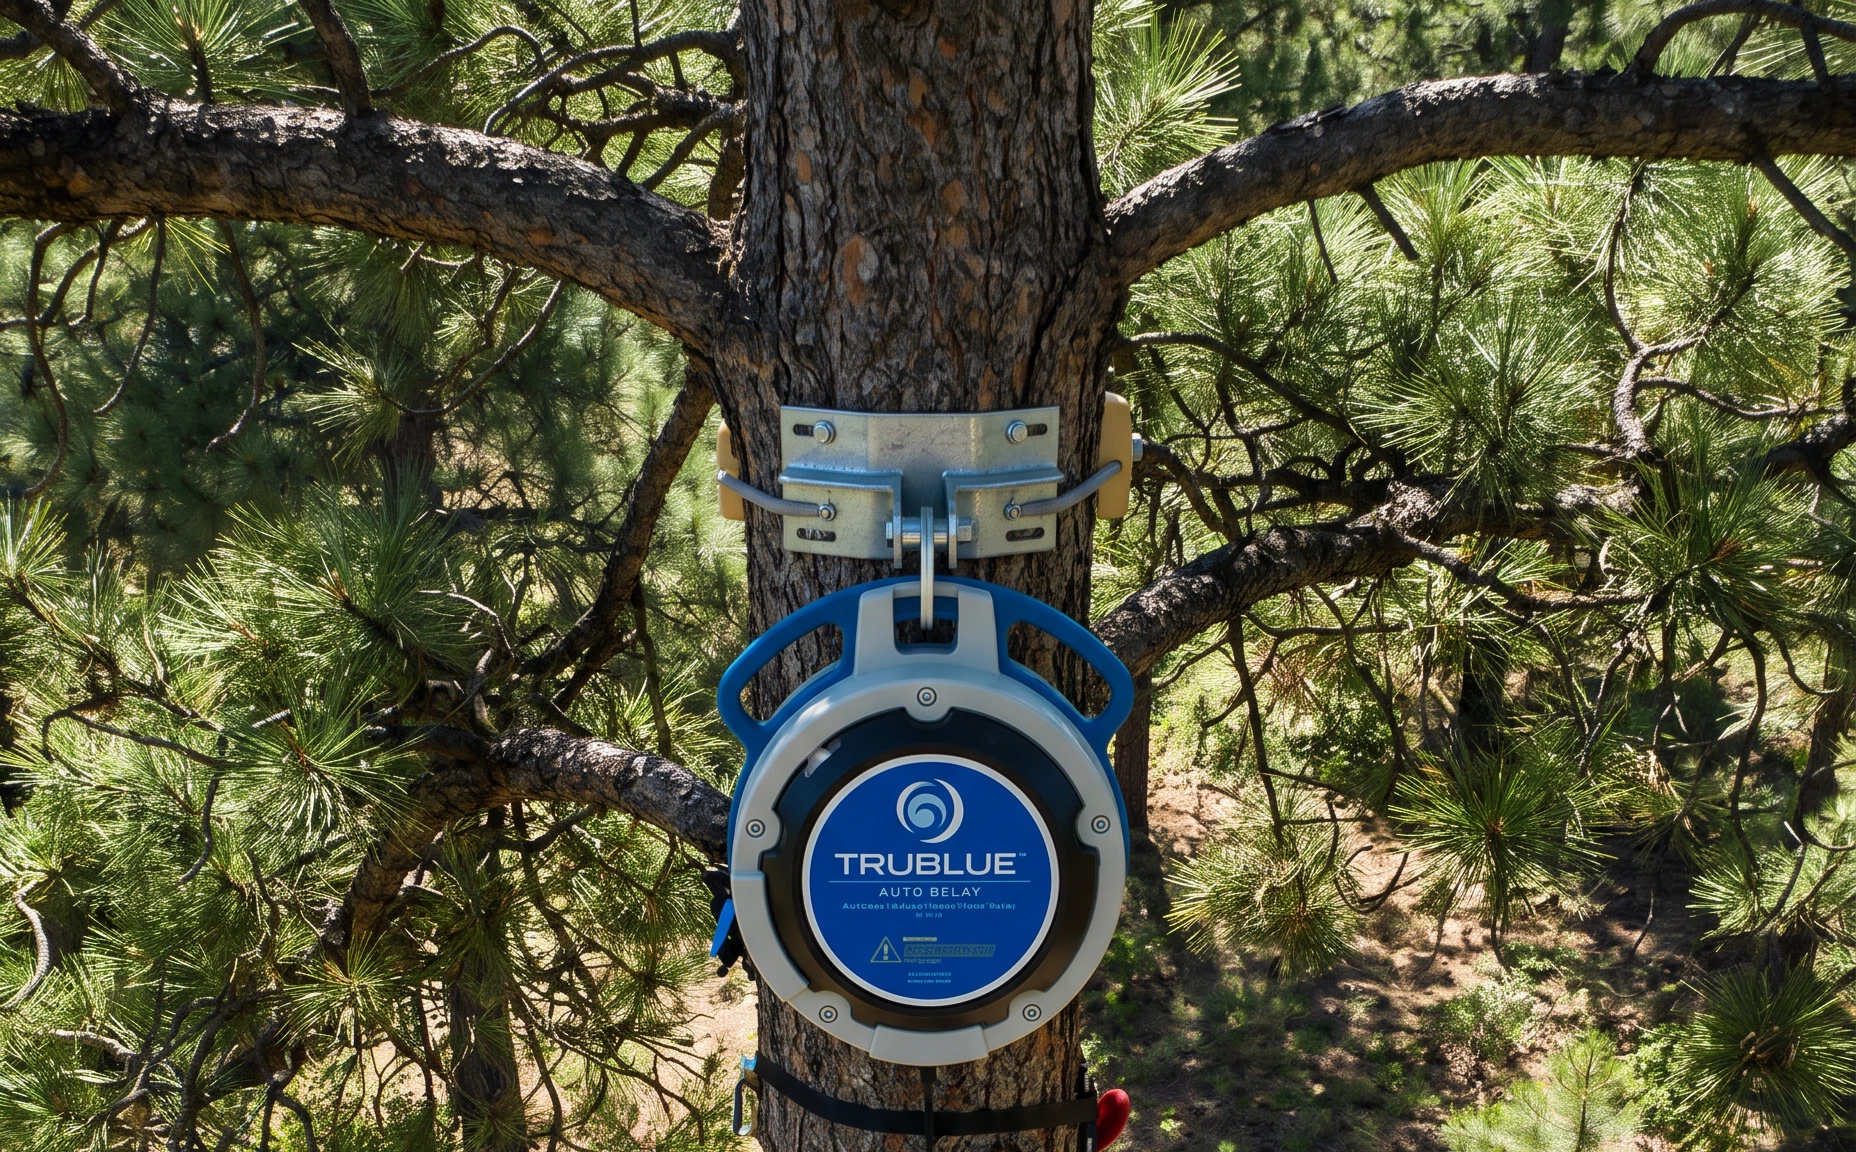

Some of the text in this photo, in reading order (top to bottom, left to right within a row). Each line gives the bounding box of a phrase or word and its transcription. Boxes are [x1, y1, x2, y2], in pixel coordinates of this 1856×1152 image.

[834, 853, 1017, 876] TRUBLUE
[879, 887, 981, 898] AUTO BELAY
